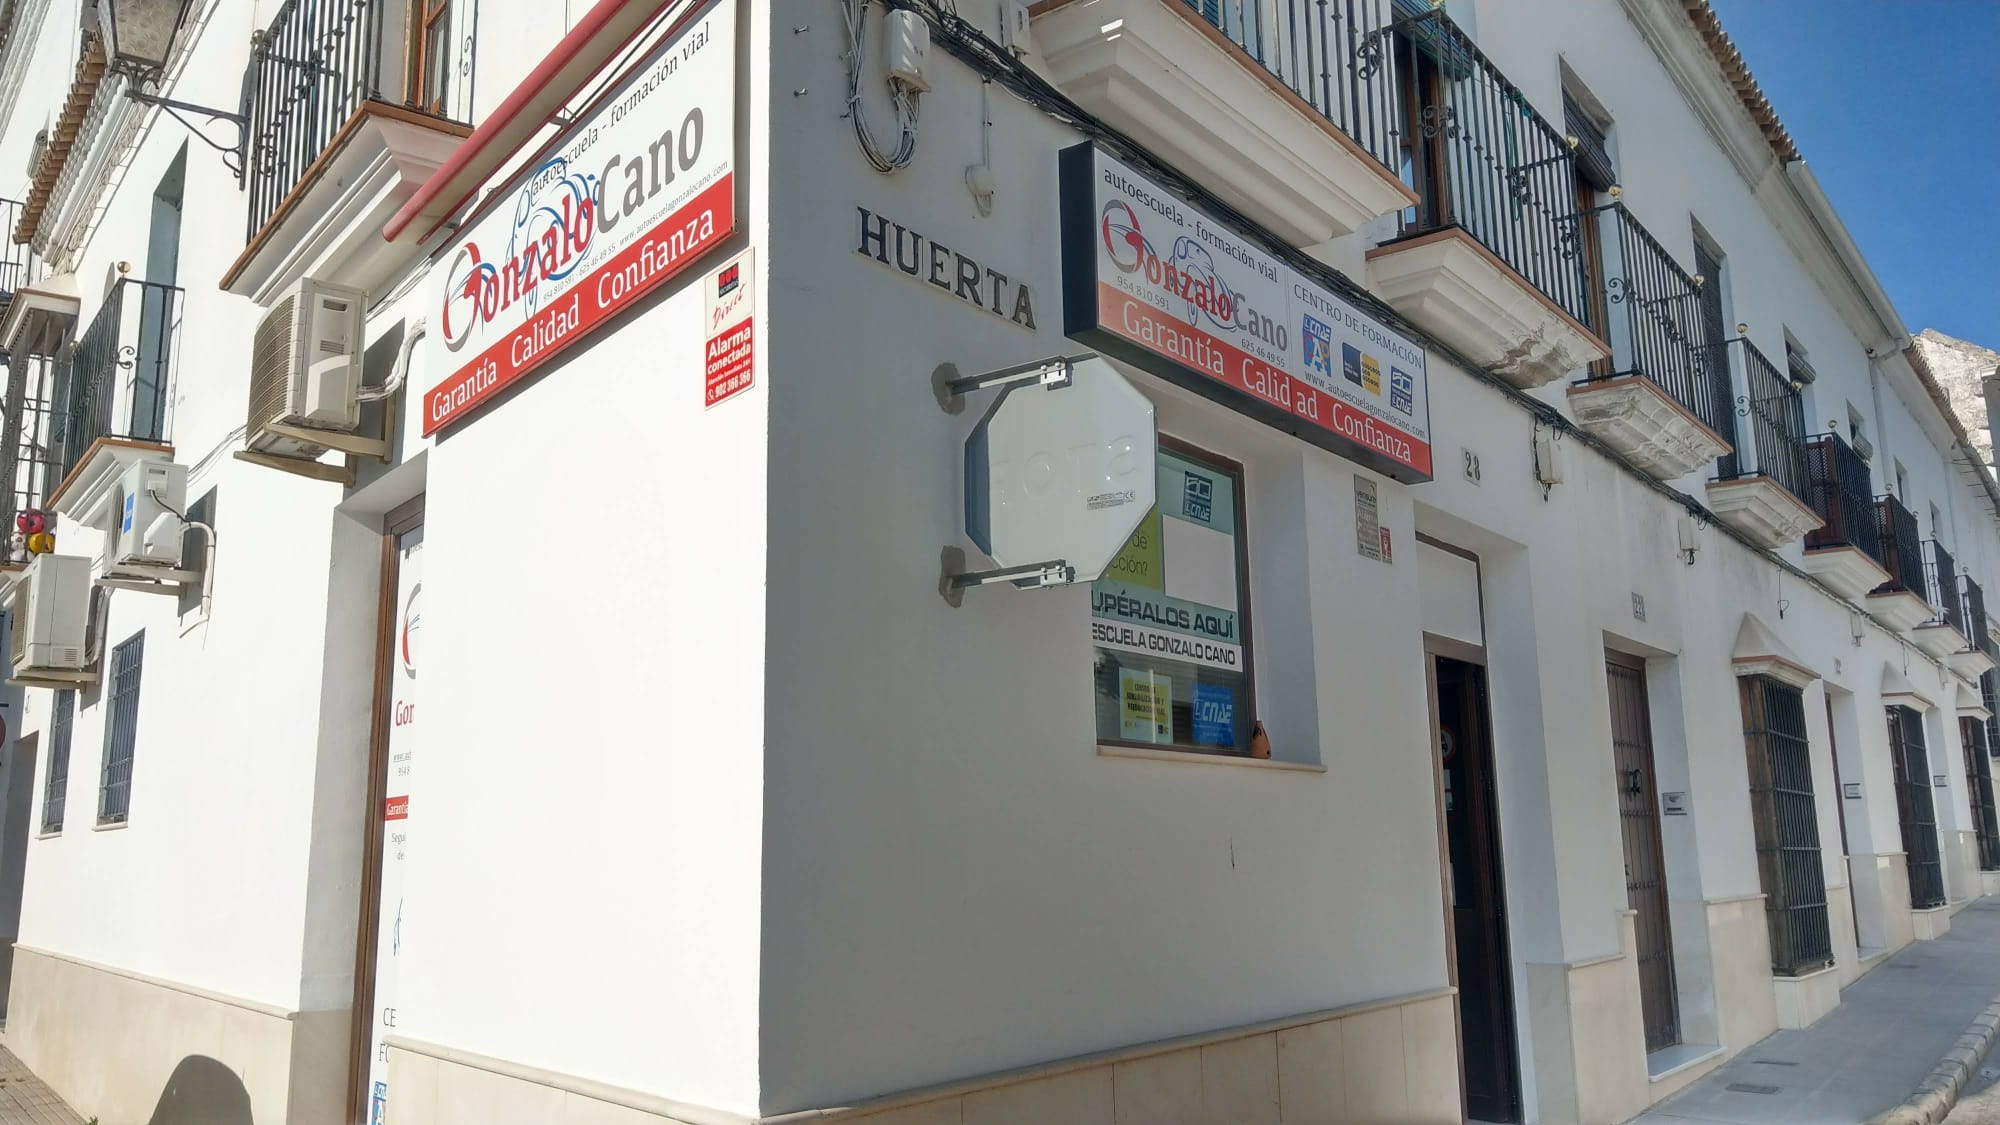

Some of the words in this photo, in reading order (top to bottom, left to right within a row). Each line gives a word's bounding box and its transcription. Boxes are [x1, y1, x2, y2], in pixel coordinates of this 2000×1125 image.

[532, 128, 598, 196] autoescuela
[611, 55, 678, 128] formación
[683, 20, 710, 62] vial
[1104, 168, 1184, 227] autoescuela
[1196, 221, 1256, 272] formación
[1258, 262, 1278, 283] vial
[857, 206, 1036, 330] HUERTA
[1117, 276, 1134, 291] 954
[1136, 286, 1153, 302] 810
[1155, 294, 1170, 311] 591
[432, 357, 497, 422] Garantía
[512, 293, 579, 368] Calidad
[597, 209, 714, 309] Confianza
[1294, 284, 1342, 322] CENTRO
[1344, 313, 1360, 333] DE
[1362, 324, 1422, 369] FORMACIÓN
[707, 343, 751, 375] conectada
[708, 326, 751, 361] Alarma
[1241, 338, 1255, 351] 625
[1257, 345, 1265, 356] 46
[1266, 351, 1275, 362] 49
[1276, 356, 1285, 367] 55
[1123, 300, 1225, 376] Garantía
[1332, 403, 1412, 463] Confianza
[1304, 370, 1426, 439] www.autoescuelagonzalocano.com
[1465, 451, 1480, 480] 28
[1148, 633, 1204, 659] GONZALO
[1205, 646, 1236, 665] CANO
[1193, 613, 1234, 639] AQUÍ
